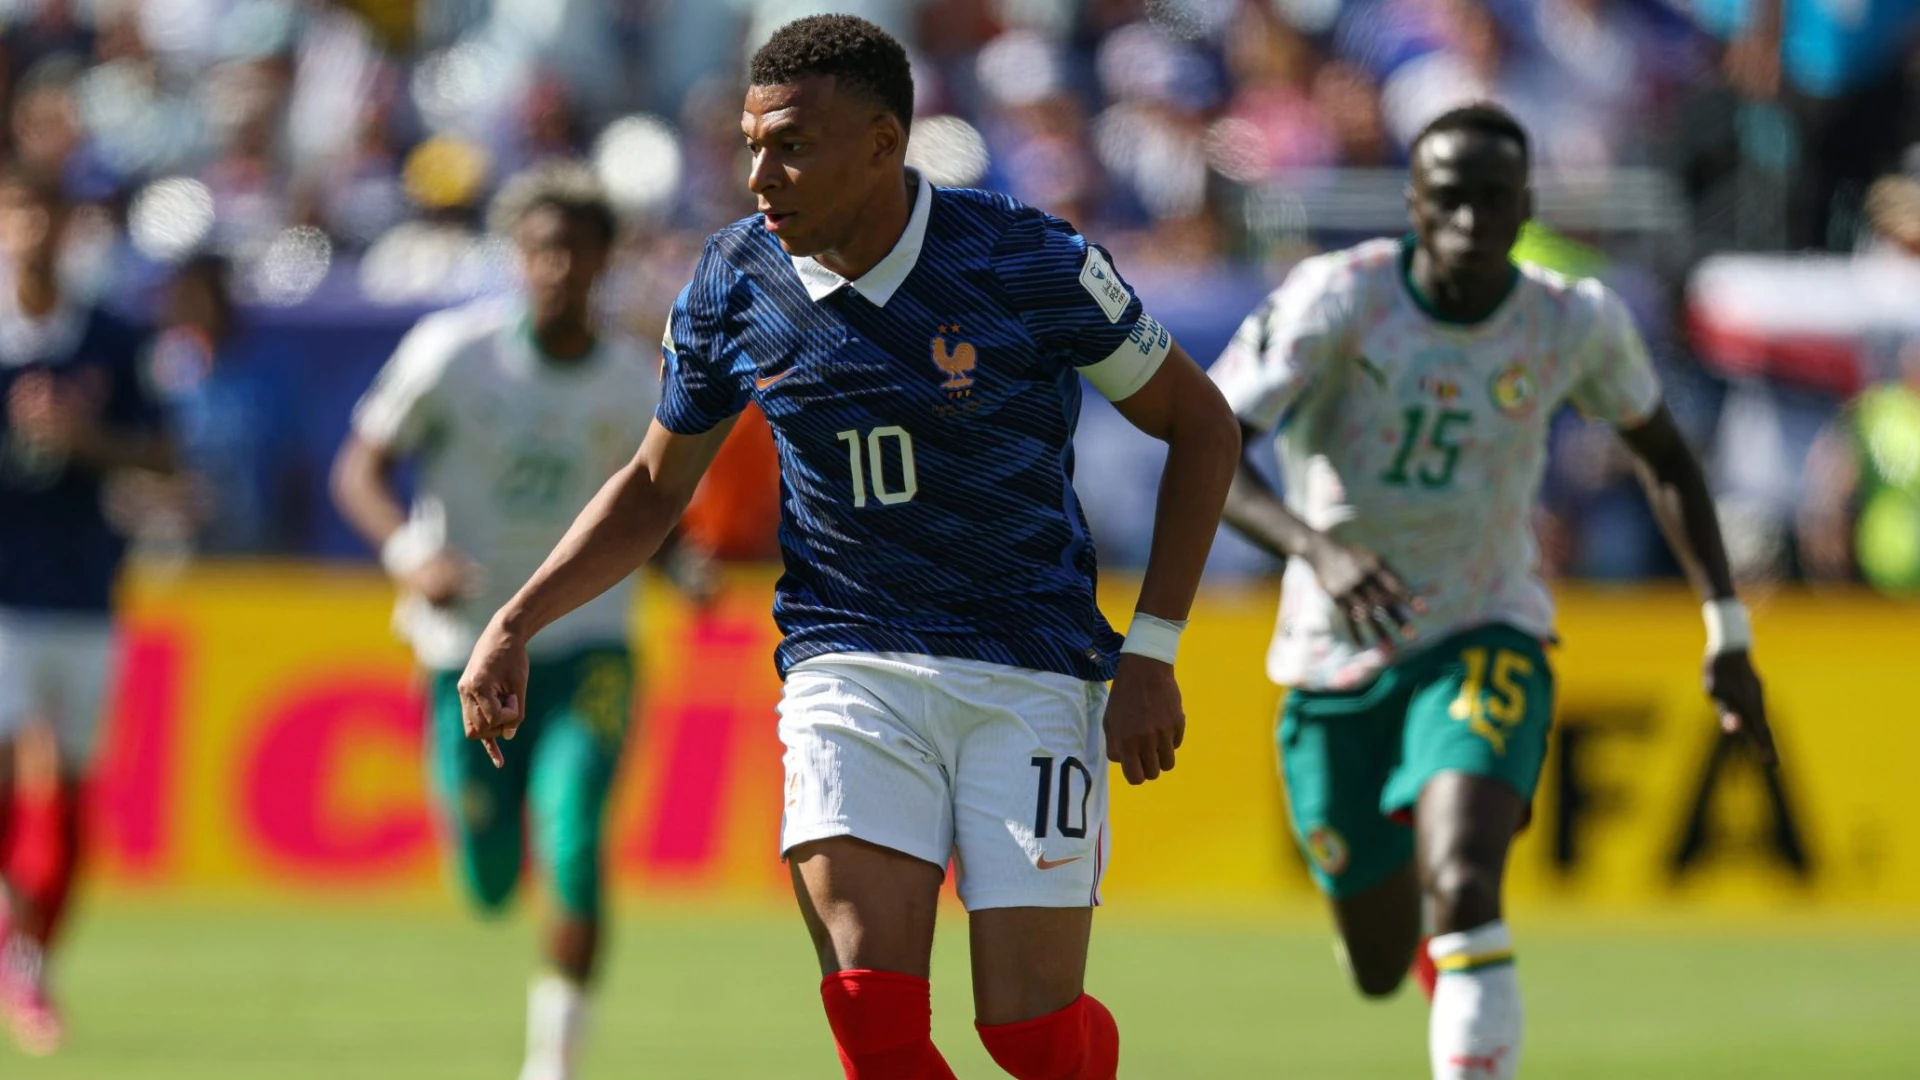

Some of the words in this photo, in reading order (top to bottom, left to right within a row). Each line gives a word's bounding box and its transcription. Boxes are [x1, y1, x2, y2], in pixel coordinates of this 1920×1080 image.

[1138, 335, 1155, 355] the
[836, 425, 918, 508] 10
[1382, 404, 1474, 491] 15
[1452, 647, 1533, 757] 15
[1030, 755, 1092, 839] 10
